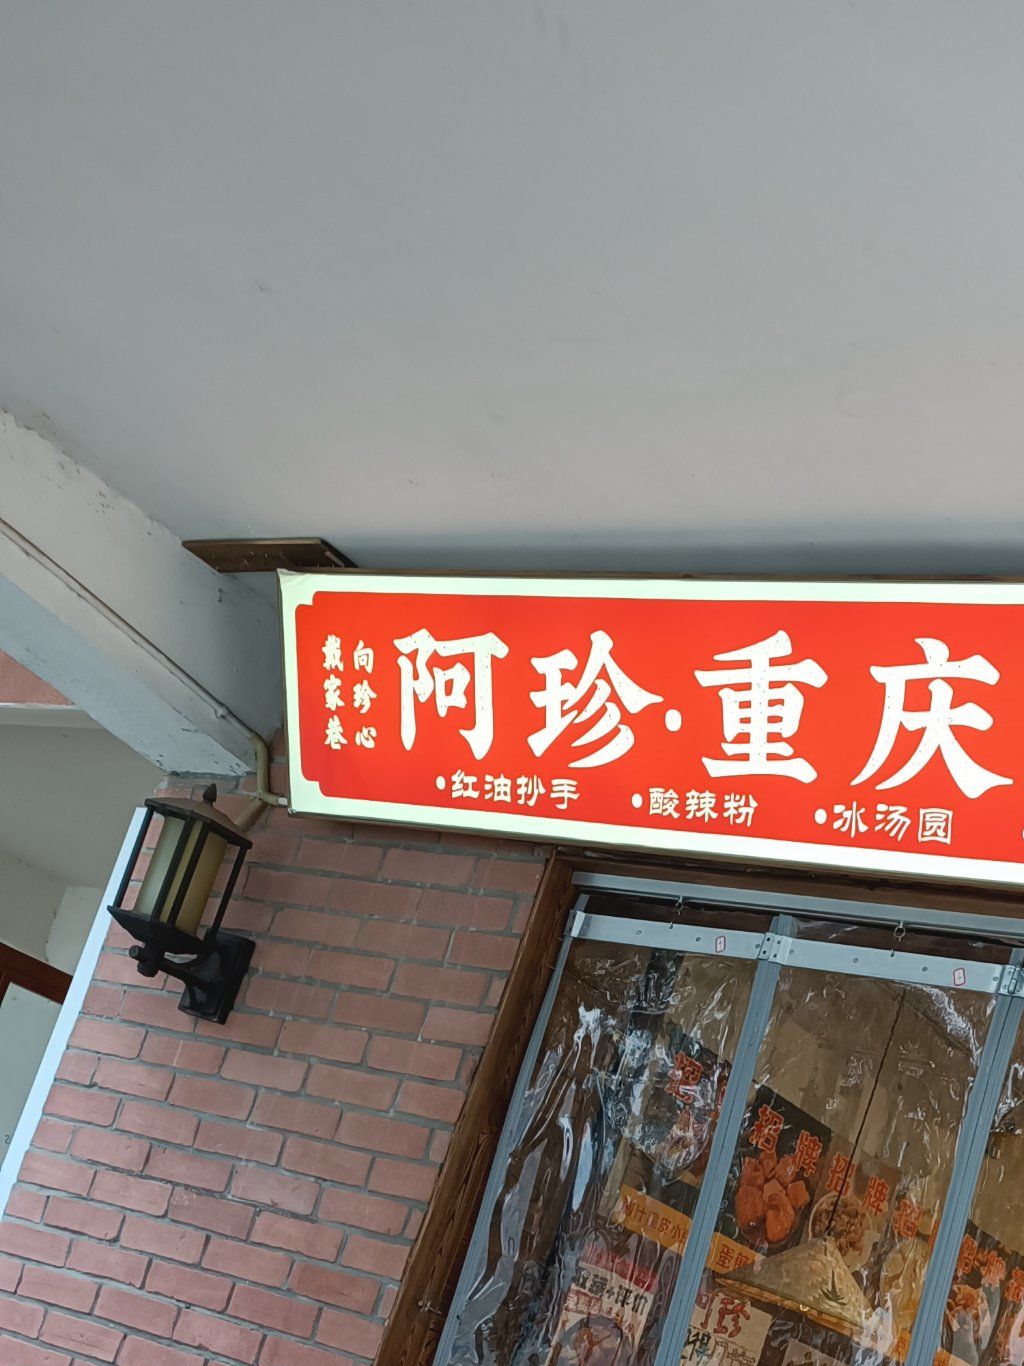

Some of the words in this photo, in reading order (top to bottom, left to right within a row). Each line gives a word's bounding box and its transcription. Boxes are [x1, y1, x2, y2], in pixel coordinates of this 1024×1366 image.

[450, 768, 580, 810] 红油抄手
[648, 786, 759, 827] 酸辣粉
[831, 802, 954, 845] 冰汤圆
